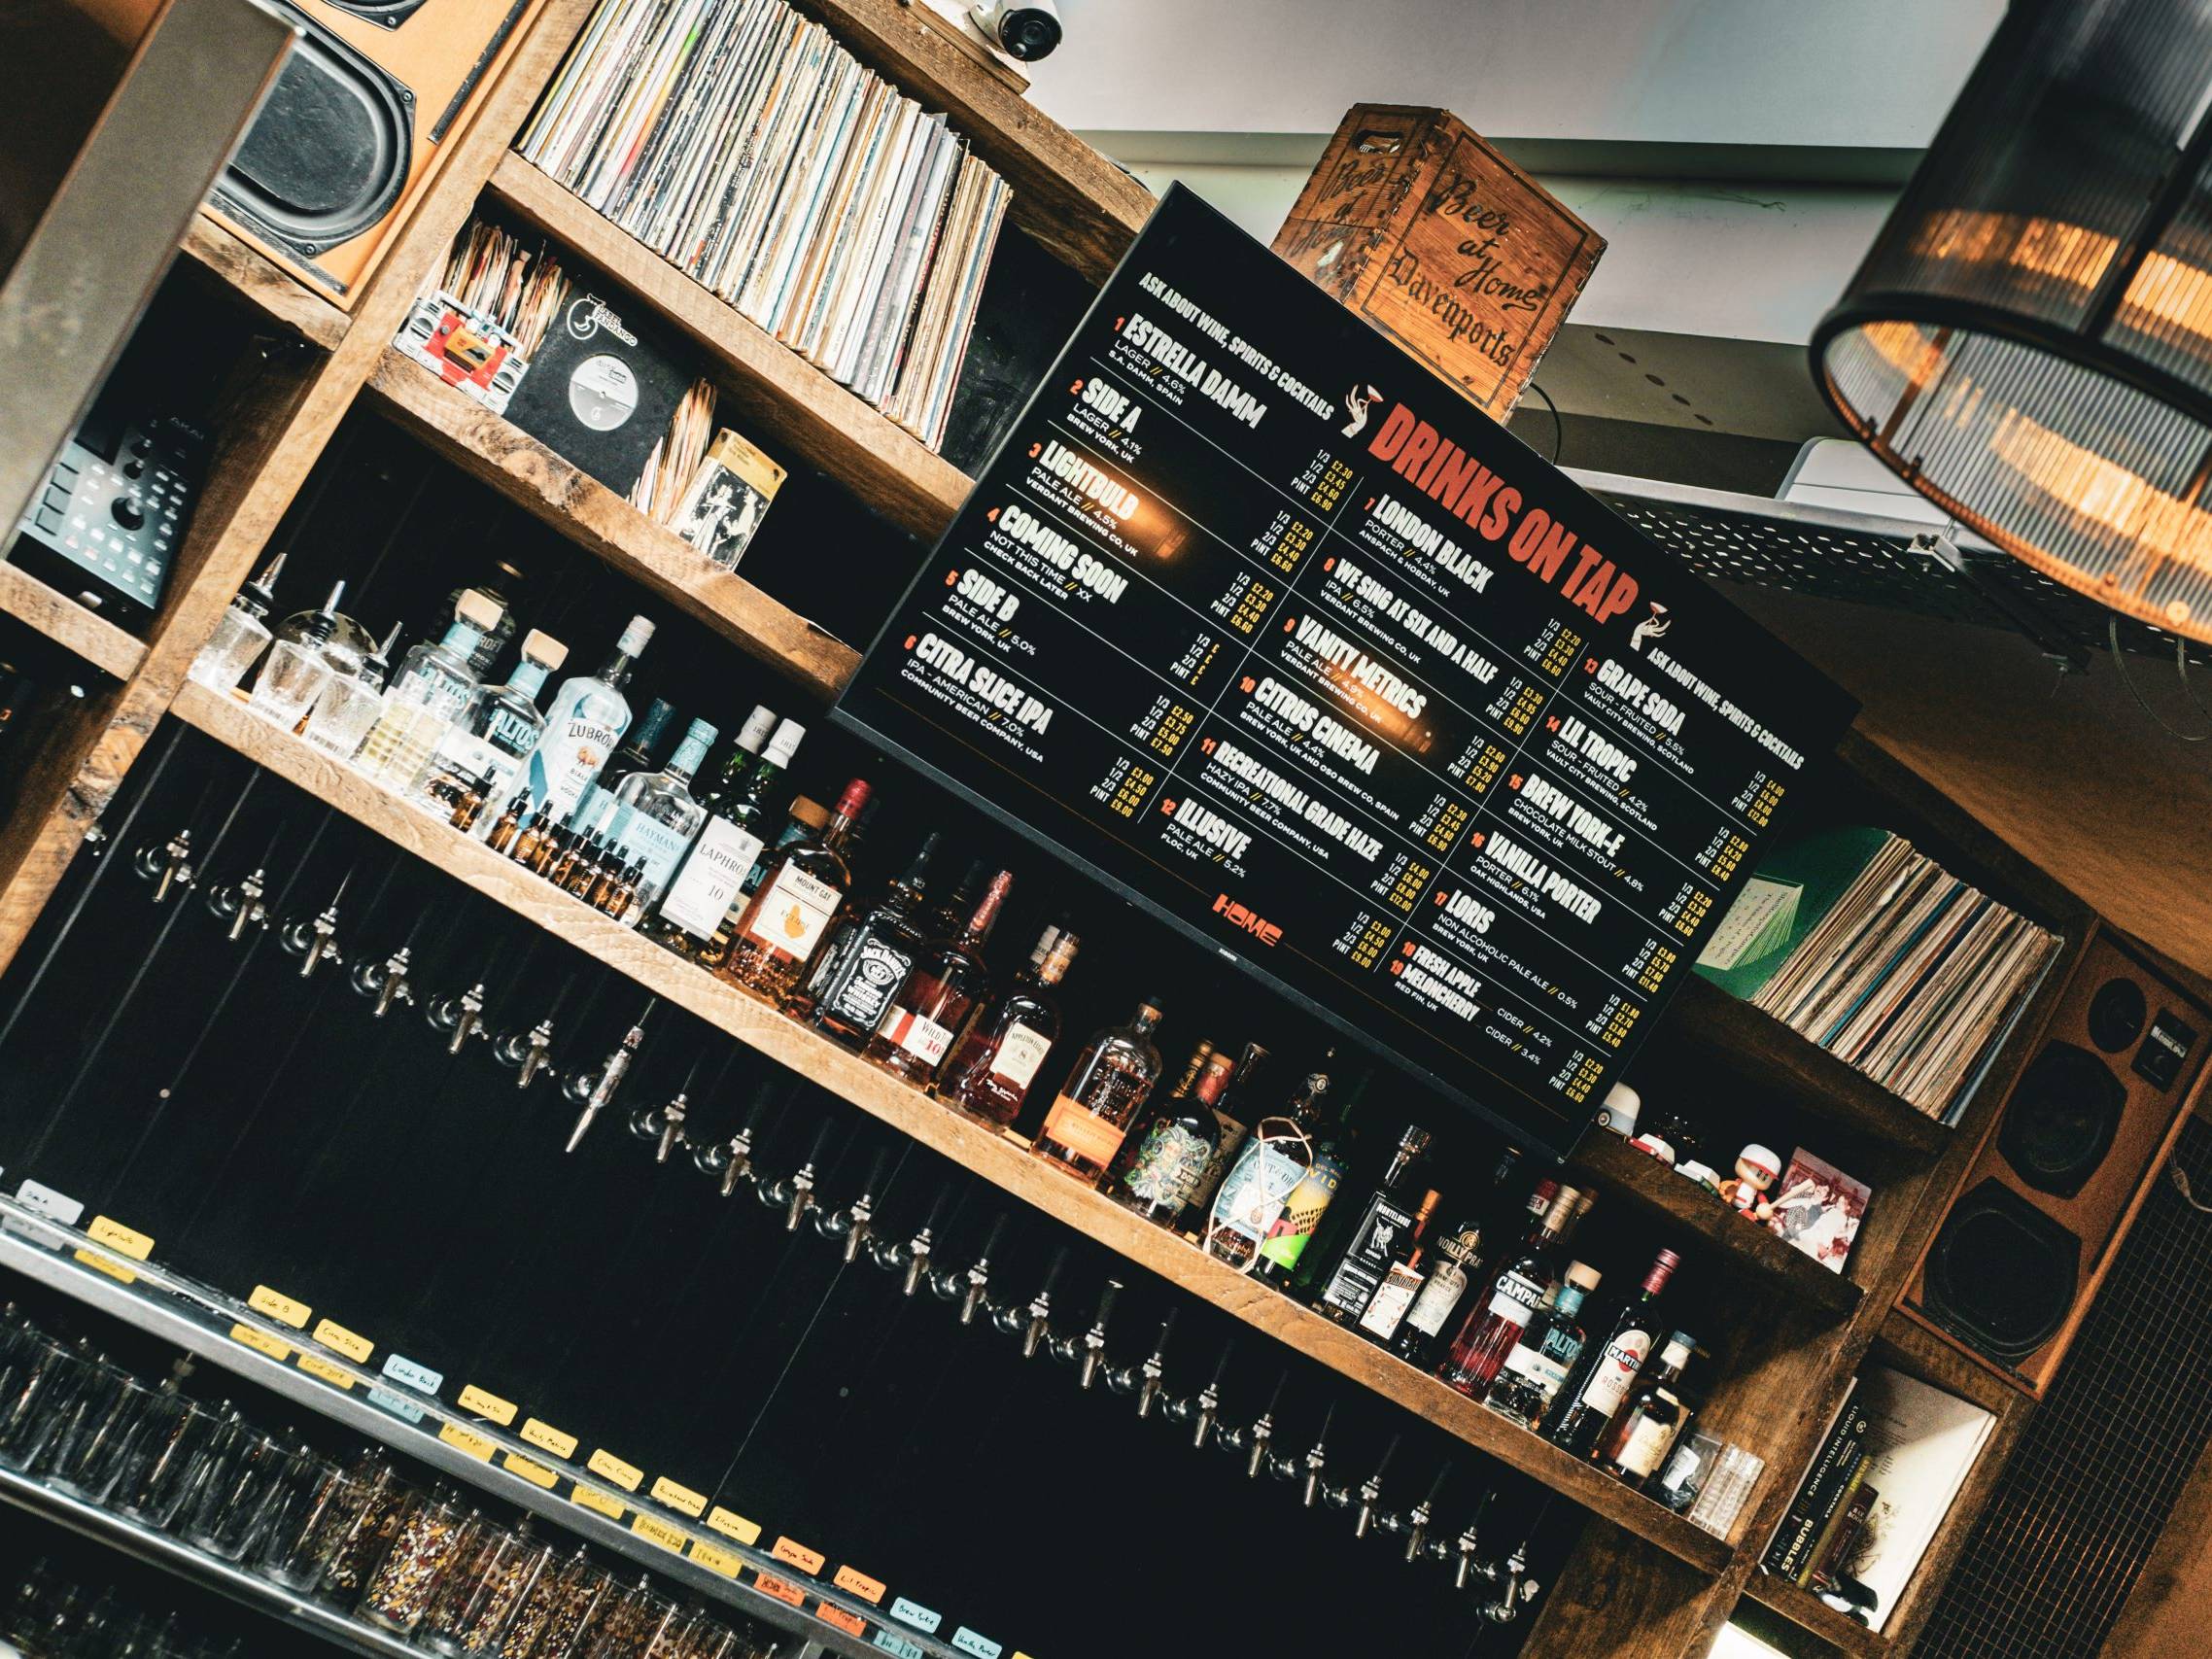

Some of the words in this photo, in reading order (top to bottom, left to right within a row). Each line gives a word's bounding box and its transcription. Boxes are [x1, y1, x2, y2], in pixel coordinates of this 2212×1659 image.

[1428, 172, 1510, 237] Beer
[1458, 235, 1501, 259] at
[1389, 248, 1515, 368] Davenports
[1454, 259, 1539, 312] Home
[591, 312, 639, 347] FANDANGO
[596, 305, 623, 326] LABEL
[1114, 316, 1125, 331] 1
[1122, 313, 1208, 389] ESTRELLA
[1199, 368, 1268, 430] DAMM
[1138, 271, 1168, 299] ASK
[1160, 288, 1202, 323] ABOUT
[1195, 311, 1230, 349] WINE,
[1227, 335, 1273, 375] SPIRITS
[1267, 364, 1281, 381] &
[1276, 371, 1335, 421] COCKTAILS
[1069, 379, 1084, 396] 2
[1081, 377, 1130, 424] SIDE
[1119, 405, 1143, 434] A
[1108, 349, 1125, 366] S.A.
[1125, 362, 1155, 388] DAMM,
[1156, 383, 1184, 406] SPAIN
[1025, 439, 1044, 461] 3
[1038, 439, 1141, 523] LIGHTBULB
[1316, 448, 1331, 464] 1/3
[1331, 460, 1354, 480] £2.30
[1290, 476, 1311, 495] PINT
[1310, 491, 1333, 511] £6.90
[1367, 402, 1523, 541] DRINKS
[1508, 508, 1578, 584] ON
[1560, 543, 1639, 624] TAP
[984, 540, 1016, 566] CHECK
[1014, 561, 1041, 582] BACK
[1039, 577, 1069, 601] LATER
[986, 507, 1001, 523] 4
[998, 504, 1079, 570] COMING
[1071, 553, 1129, 605] SOON
[1358, 530, 1399, 560] ANSPACH
[1397, 556, 1404, 565] &
[1403, 561, 1437, 590] HOBDAY,
[1437, 585, 1451, 598] UK
[1364, 497, 1376, 511] 7
[1371, 493, 1444, 558] LONDON
[1434, 538, 1495, 595] BLACK
[945, 570, 959, 586] 5
[956, 569, 1007, 614] SIDE
[995, 593, 1020, 622] B
[1323, 557, 1335, 572] 8
[1333, 557, 1364, 590] WE
[1355, 574, 1394, 611] SING
[1385, 598, 1411, 622] AT
[1402, 608, 1433, 639] SIX
[1423, 624, 1458, 656] AND
[1449, 643, 1468, 665] A
[1460, 649, 1500, 685] HALF
[904, 635, 917, 650] 6
[916, 632, 976, 685] CITRA
[968, 666, 1026, 716] SLICE
[1015, 695, 1054, 736] IPA
[1281, 615, 1298, 635] 9
[1292, 614, 1360, 674] VANITY
[1348, 653, 1429, 721] METRICS
[1239, 675, 1257, 694] 10
[1254, 676, 1320, 732] CITRUS
[1311, 715, 1381, 776] CINEMA
[1583, 657, 1599, 674] 13
[1597, 658, 1651, 709] GRAPE
[1642, 692, 1686, 737] SODA
[1646, 646, 1672, 671] ASK
[1664, 660, 1699, 691] ABOUT
[1692, 679, 1722, 711] WINE,
[1717, 700, 1755, 734] SPIRITS
[1749, 723, 1762, 739] &
[1757, 729, 1805, 771] COCKTAILS
[490, 708, 540, 748] ALTOS
[1545, 715, 1561, 733] 14
[1558, 715, 1587, 748] LIL
[1579, 729, 1638, 783] TROPIC
[1583, 690, 1607, 710] VAULT
[1606, 708, 1624, 722] CITY
[1621, 719, 1656, 749] BREWING,
[1656, 744, 1695, 775] SCOTLAND
[1160, 798, 1177, 816] 12
[1173, 797, 1253, 860] ILLUSIVE
[1200, 738, 1217, 755] 11
[1213, 740, 1310, 815] RECREATIONAL
[1303, 800, 1353, 842] GRADE
[1343, 826, 1384, 863] HAZE
[1508, 774, 1524, 790] 15
[1520, 773, 1575, 821] BREW
[1566, 804, 1626, 858] YORK-E
[1160, 832, 1185, 853] FLOC,
[1185, 847, 1199, 860] UK
[707, 884, 725, 902] 10
[793, 874, 819, 894] MOUNT
[816, 887, 833, 902] GAY
[1470, 831, 1486, 848] 16
[1484, 830, 1548, 889] VANILLA
[1540, 870, 1602, 925] PORTER
[1212, 893, 1284, 947] HOME
[1434, 890, 1448, 907] 17
[1444, 888, 1496, 934] LORIS
[859, 946, 880, 962] JACK
[1401, 941, 1417, 957] 18
[1411, 945, 1451, 979] FRESH
[1443, 966, 1482, 999] APPLE
[846, 985, 881, 1009] WHISKEY
[1390, 959, 1404, 976] 19
[1400, 962, 1481, 1022] MELONCHERRY
[1394, 981, 1412, 994] RED
[1410, 990, 1426, 1006] FIN,
[1426, 1000, 1439, 1012] UK
[919, 1020, 943, 1041] WILD
[1010, 1029, 1034, 1048] APPLETON
[1435, 1235, 1467, 1259] NOILLY
[1841, 1404, 1859, 1437] LIQUID
[1807, 1436, 1843, 1498] INTELLIGENCE
[1823, 1484, 1845, 1518] COCKTAILS
[1780, 1518, 1815, 1572] BUBBLES
